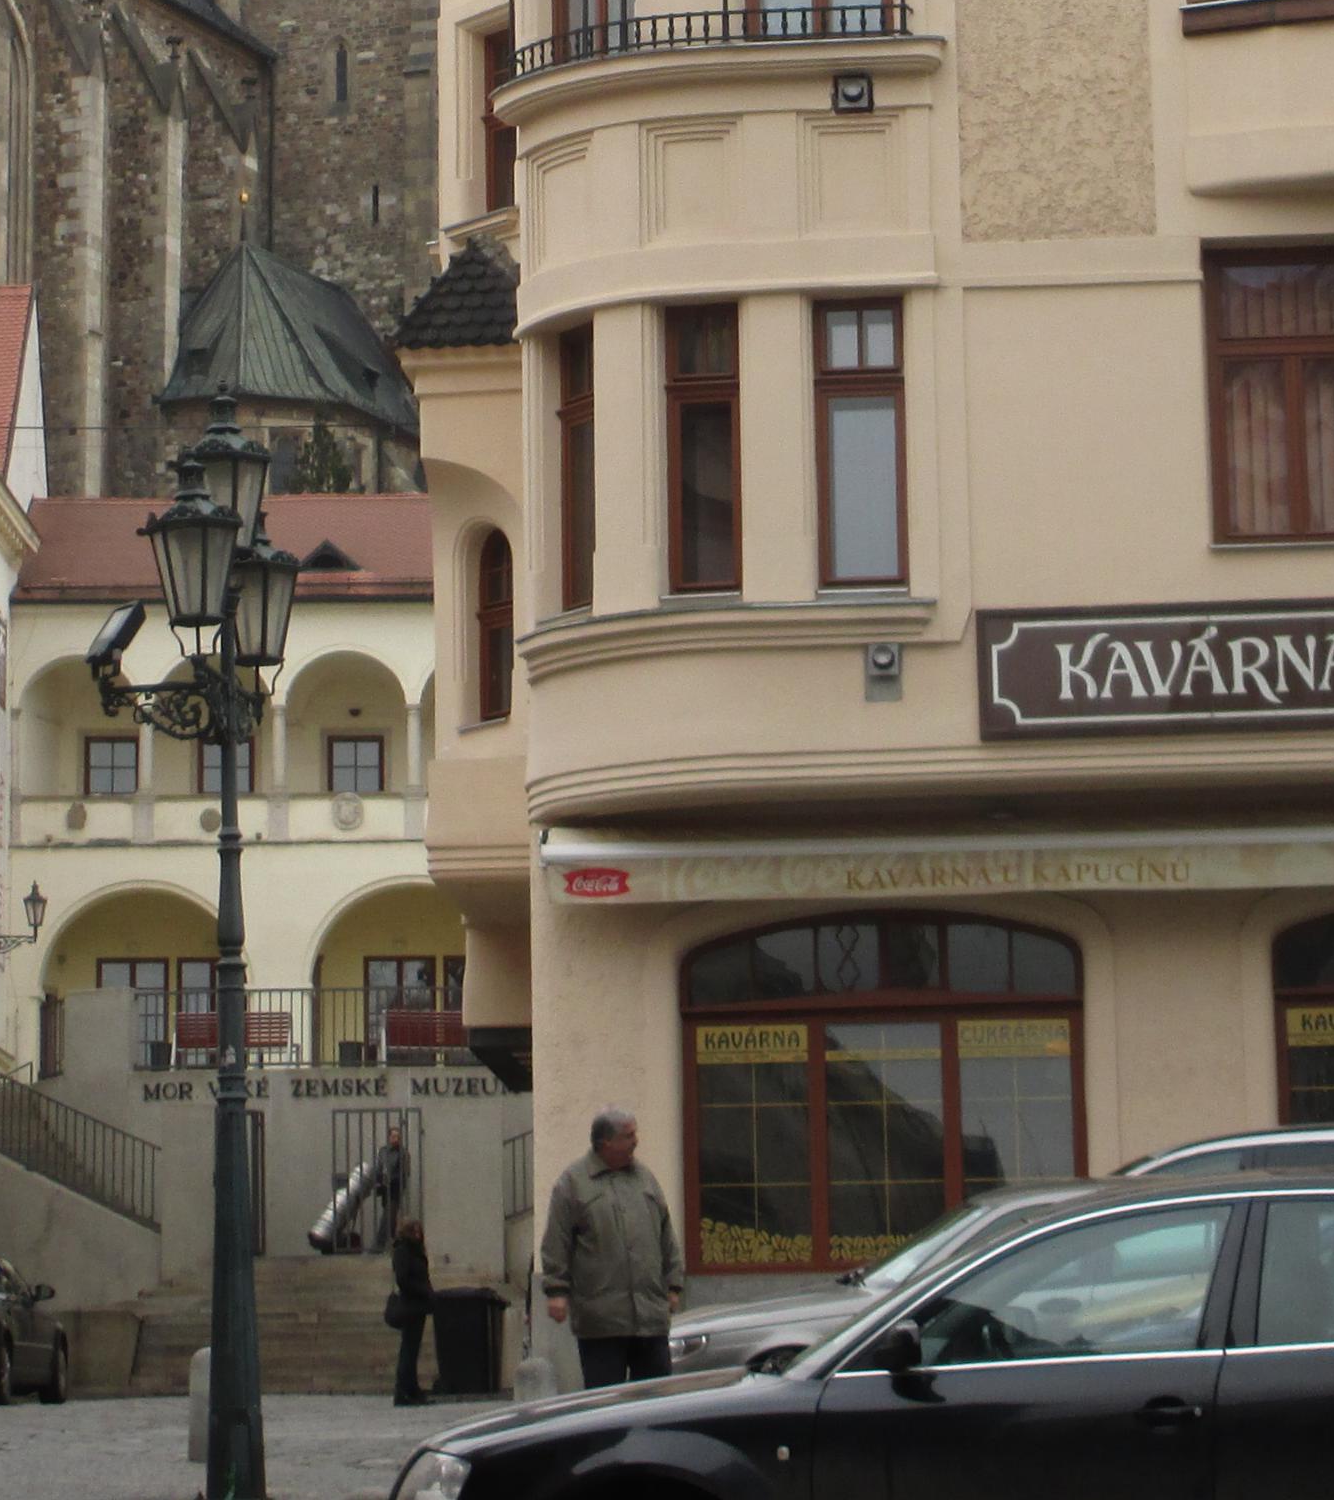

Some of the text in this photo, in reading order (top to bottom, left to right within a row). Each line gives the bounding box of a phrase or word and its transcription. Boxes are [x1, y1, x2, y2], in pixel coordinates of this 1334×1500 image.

[704, 1027, 801, 1050] KAVÁRNA
[290, 1075, 388, 1098] ZEMSKÉ
[410, 1075, 519, 1098] MUZEU
